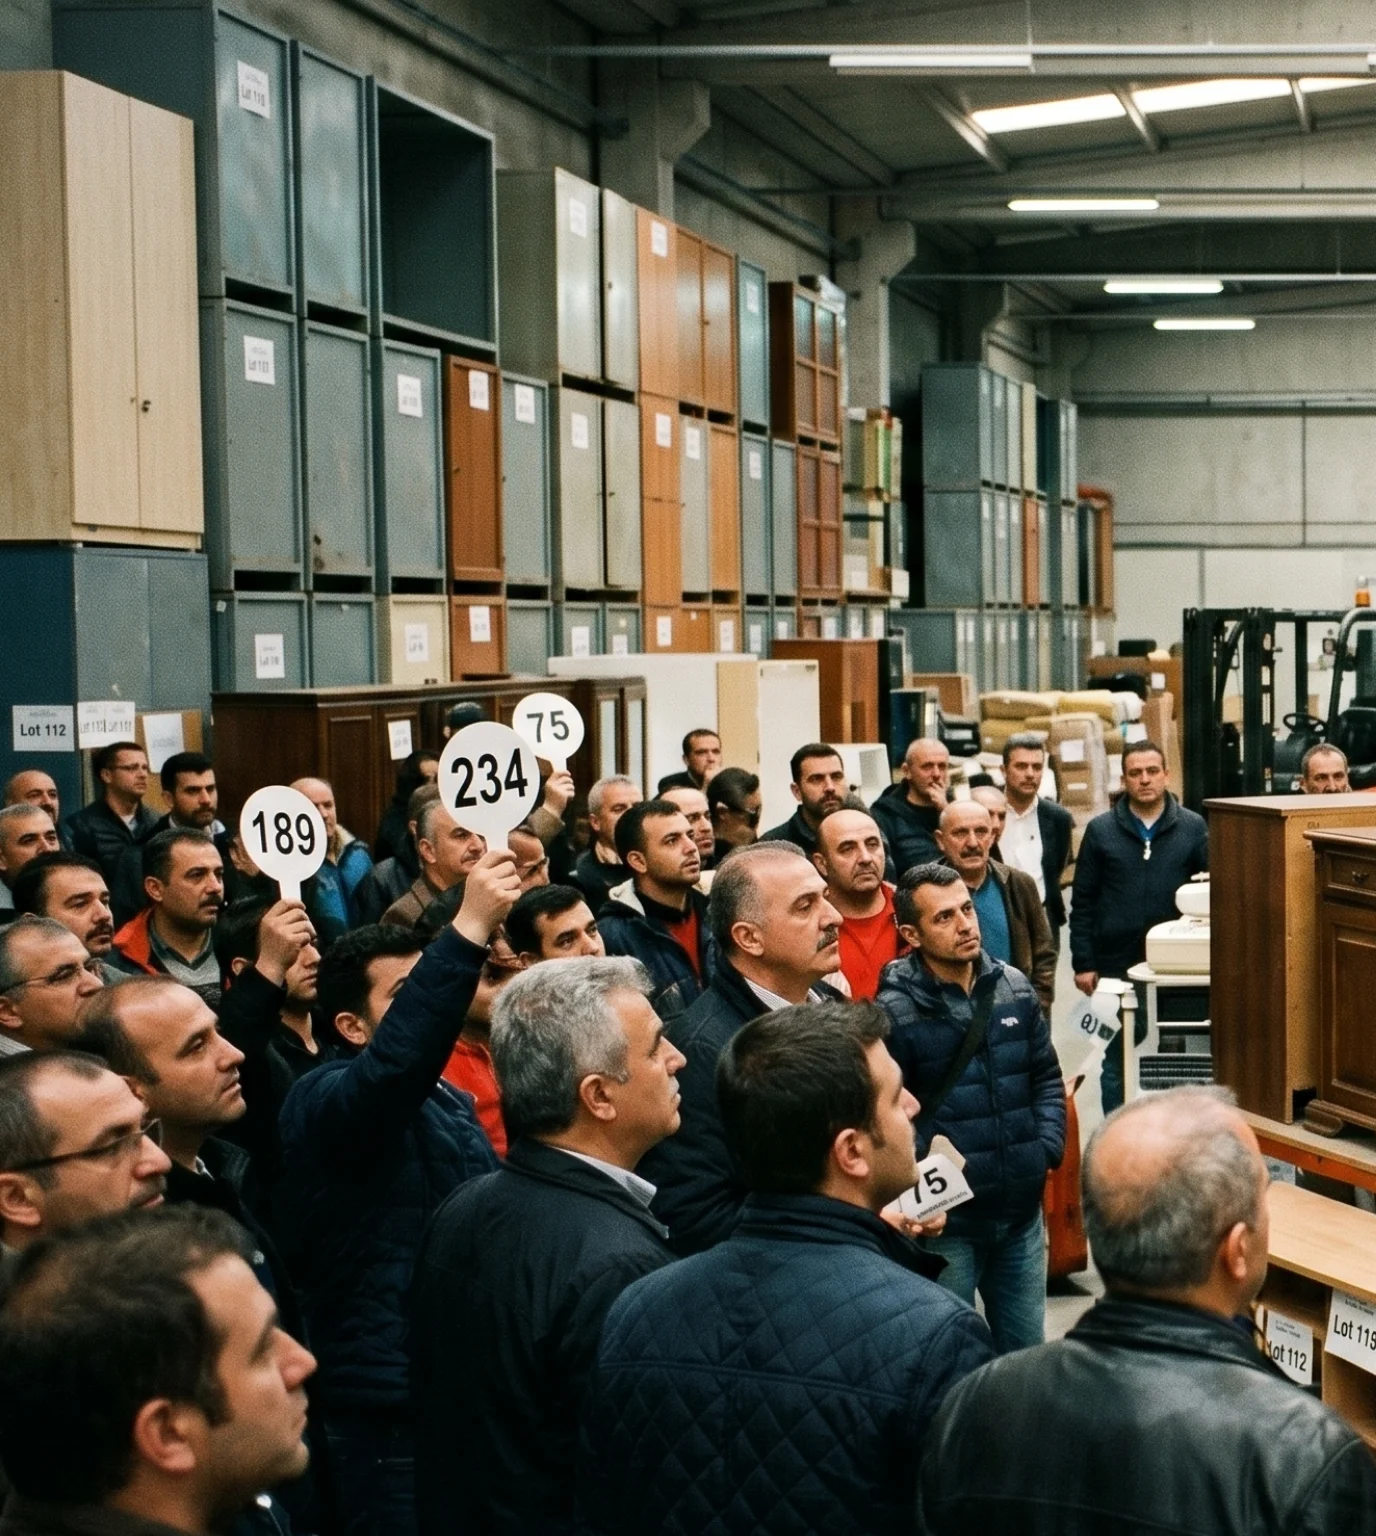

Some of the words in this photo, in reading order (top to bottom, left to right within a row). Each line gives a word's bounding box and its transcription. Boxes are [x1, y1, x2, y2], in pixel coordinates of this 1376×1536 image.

[20, 723, 41, 737] Lot
[45, 723, 66, 737] 112
[527, 710, 570, 743] 75
[451, 748, 528, 809] 234
[252, 810, 315, 855] 189
[1333, 1314, 1354, 1340] Lot
[1288, 1347, 1307, 1372] 112
